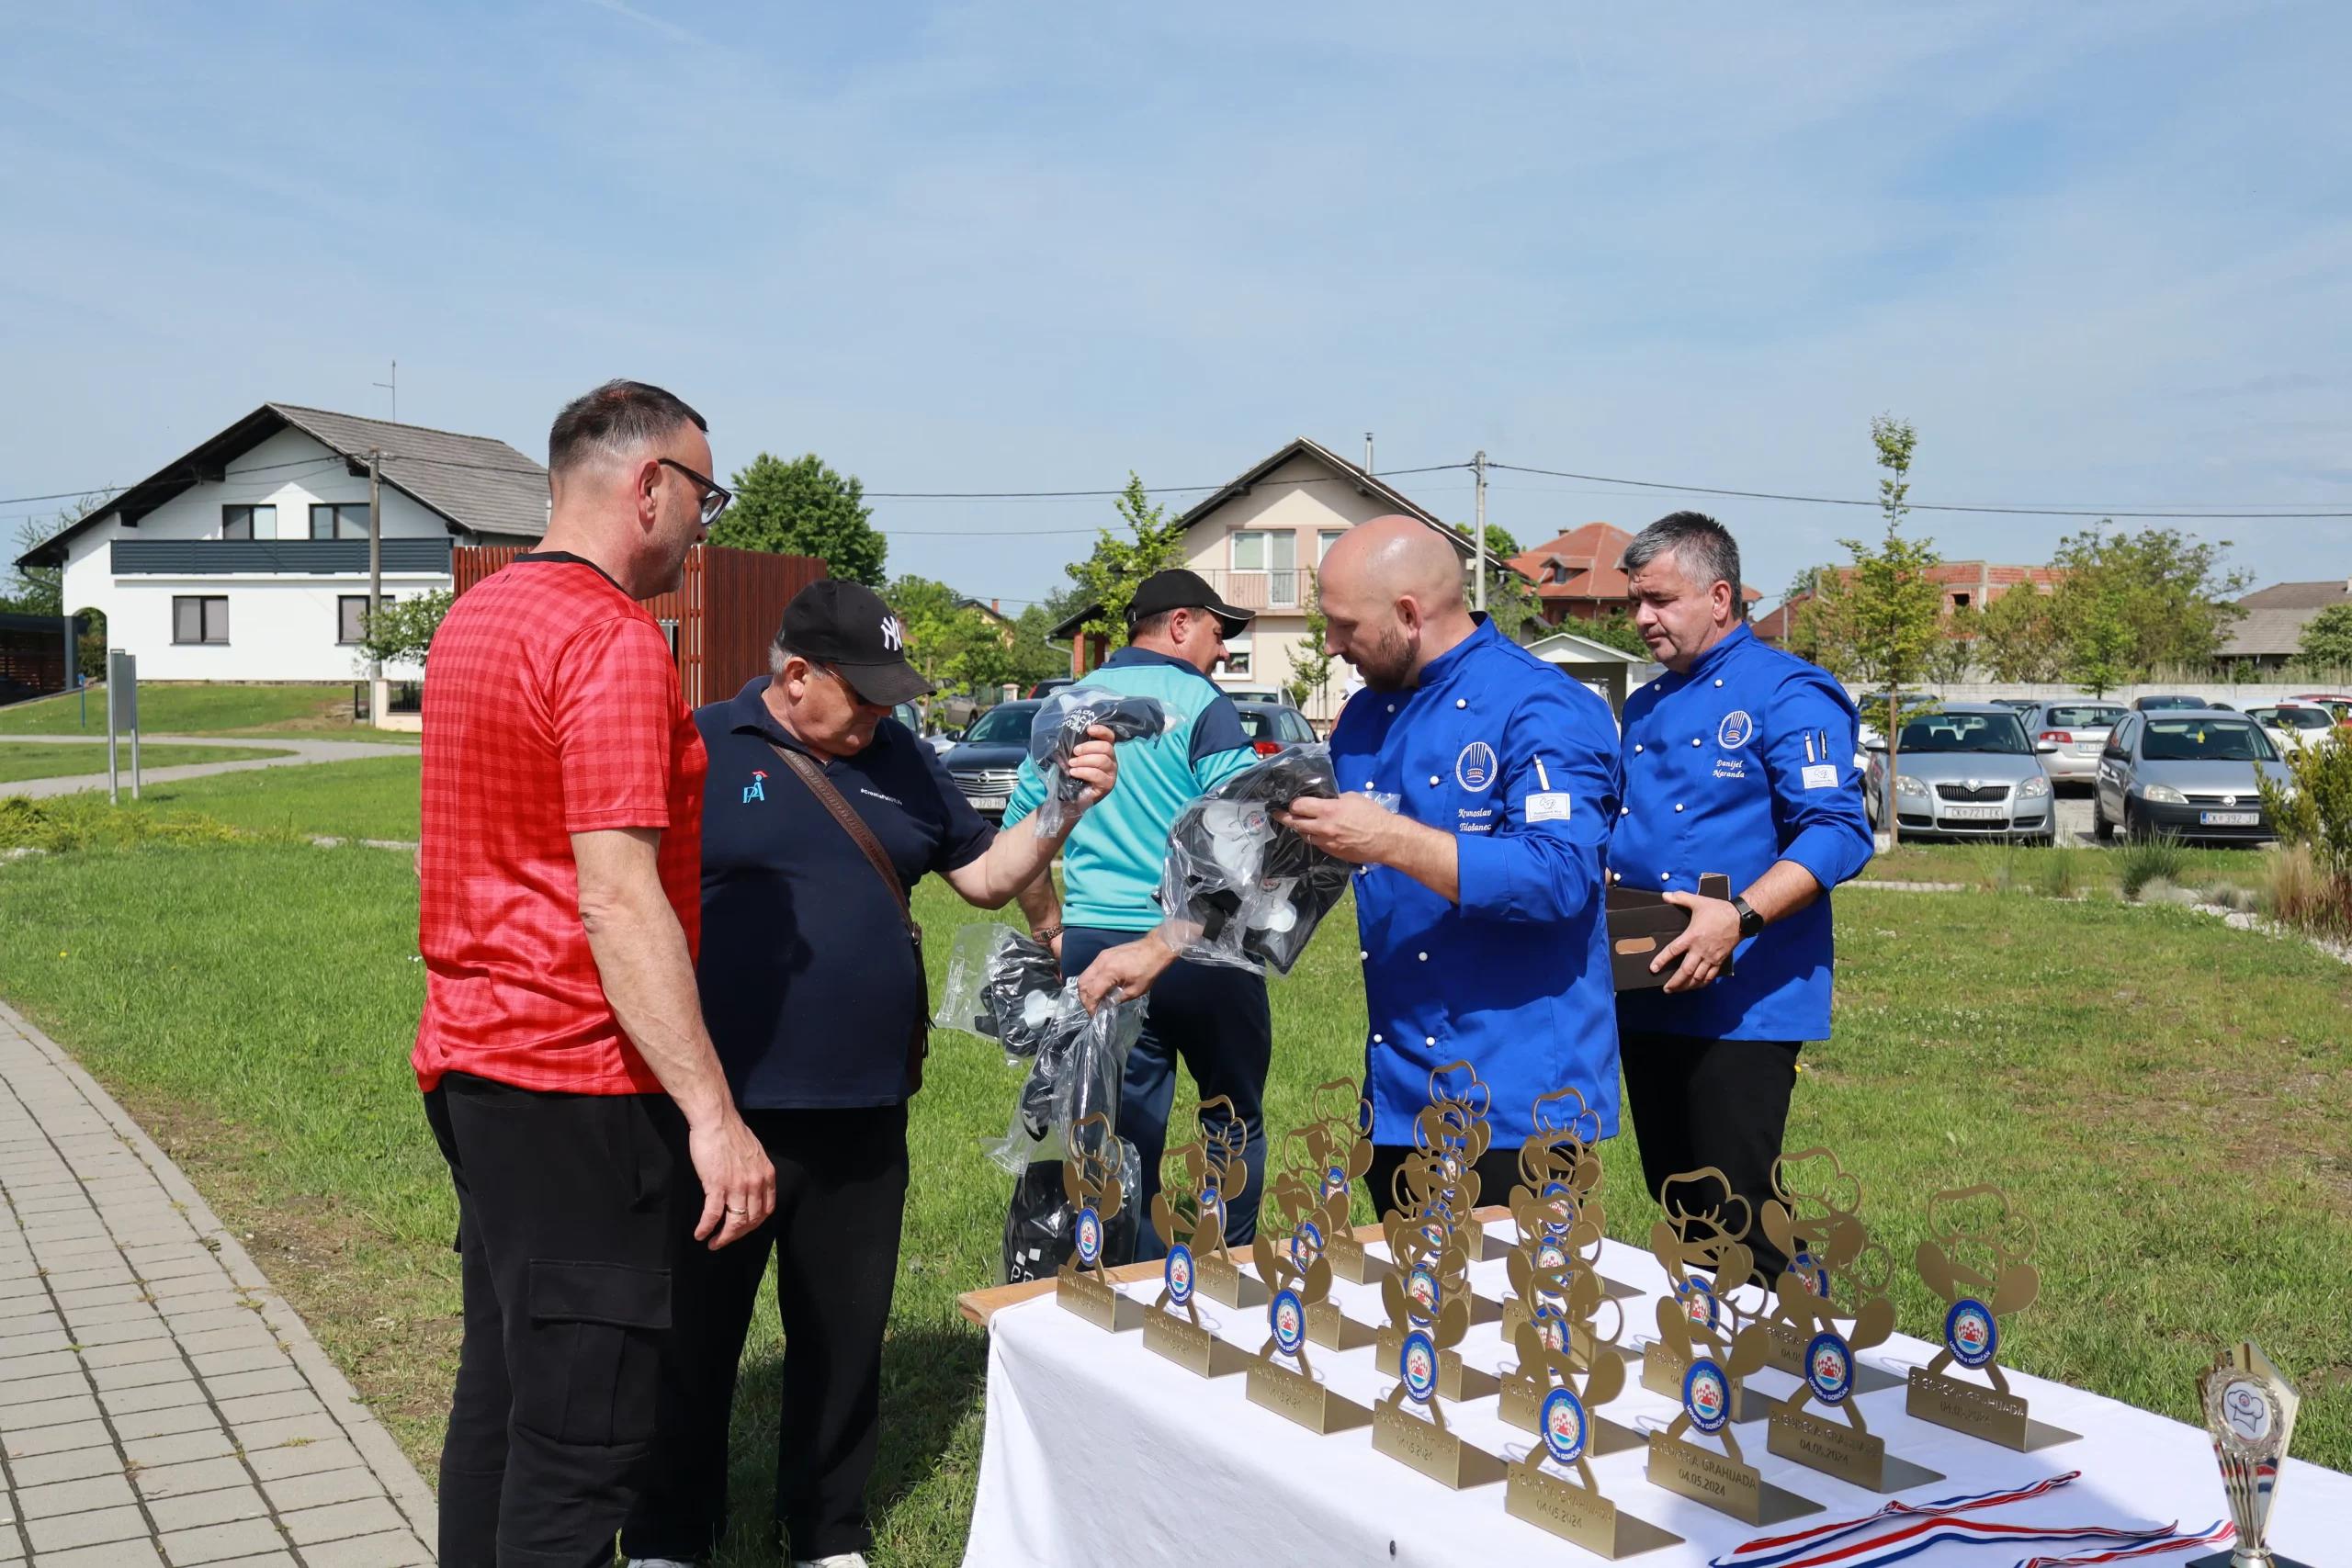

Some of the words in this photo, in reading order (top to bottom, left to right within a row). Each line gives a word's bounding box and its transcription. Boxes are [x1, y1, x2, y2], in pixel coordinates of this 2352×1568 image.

[1716, 759, 1744, 770] Danijel
[1457, 807, 1492, 818] Krunoslav
[1679, 1468, 1726, 1496] 04.05.2024
[1702, 1459, 1757, 1491] GRAHIJADA
[1535, 1499, 1583, 1529] 04.05.2024
